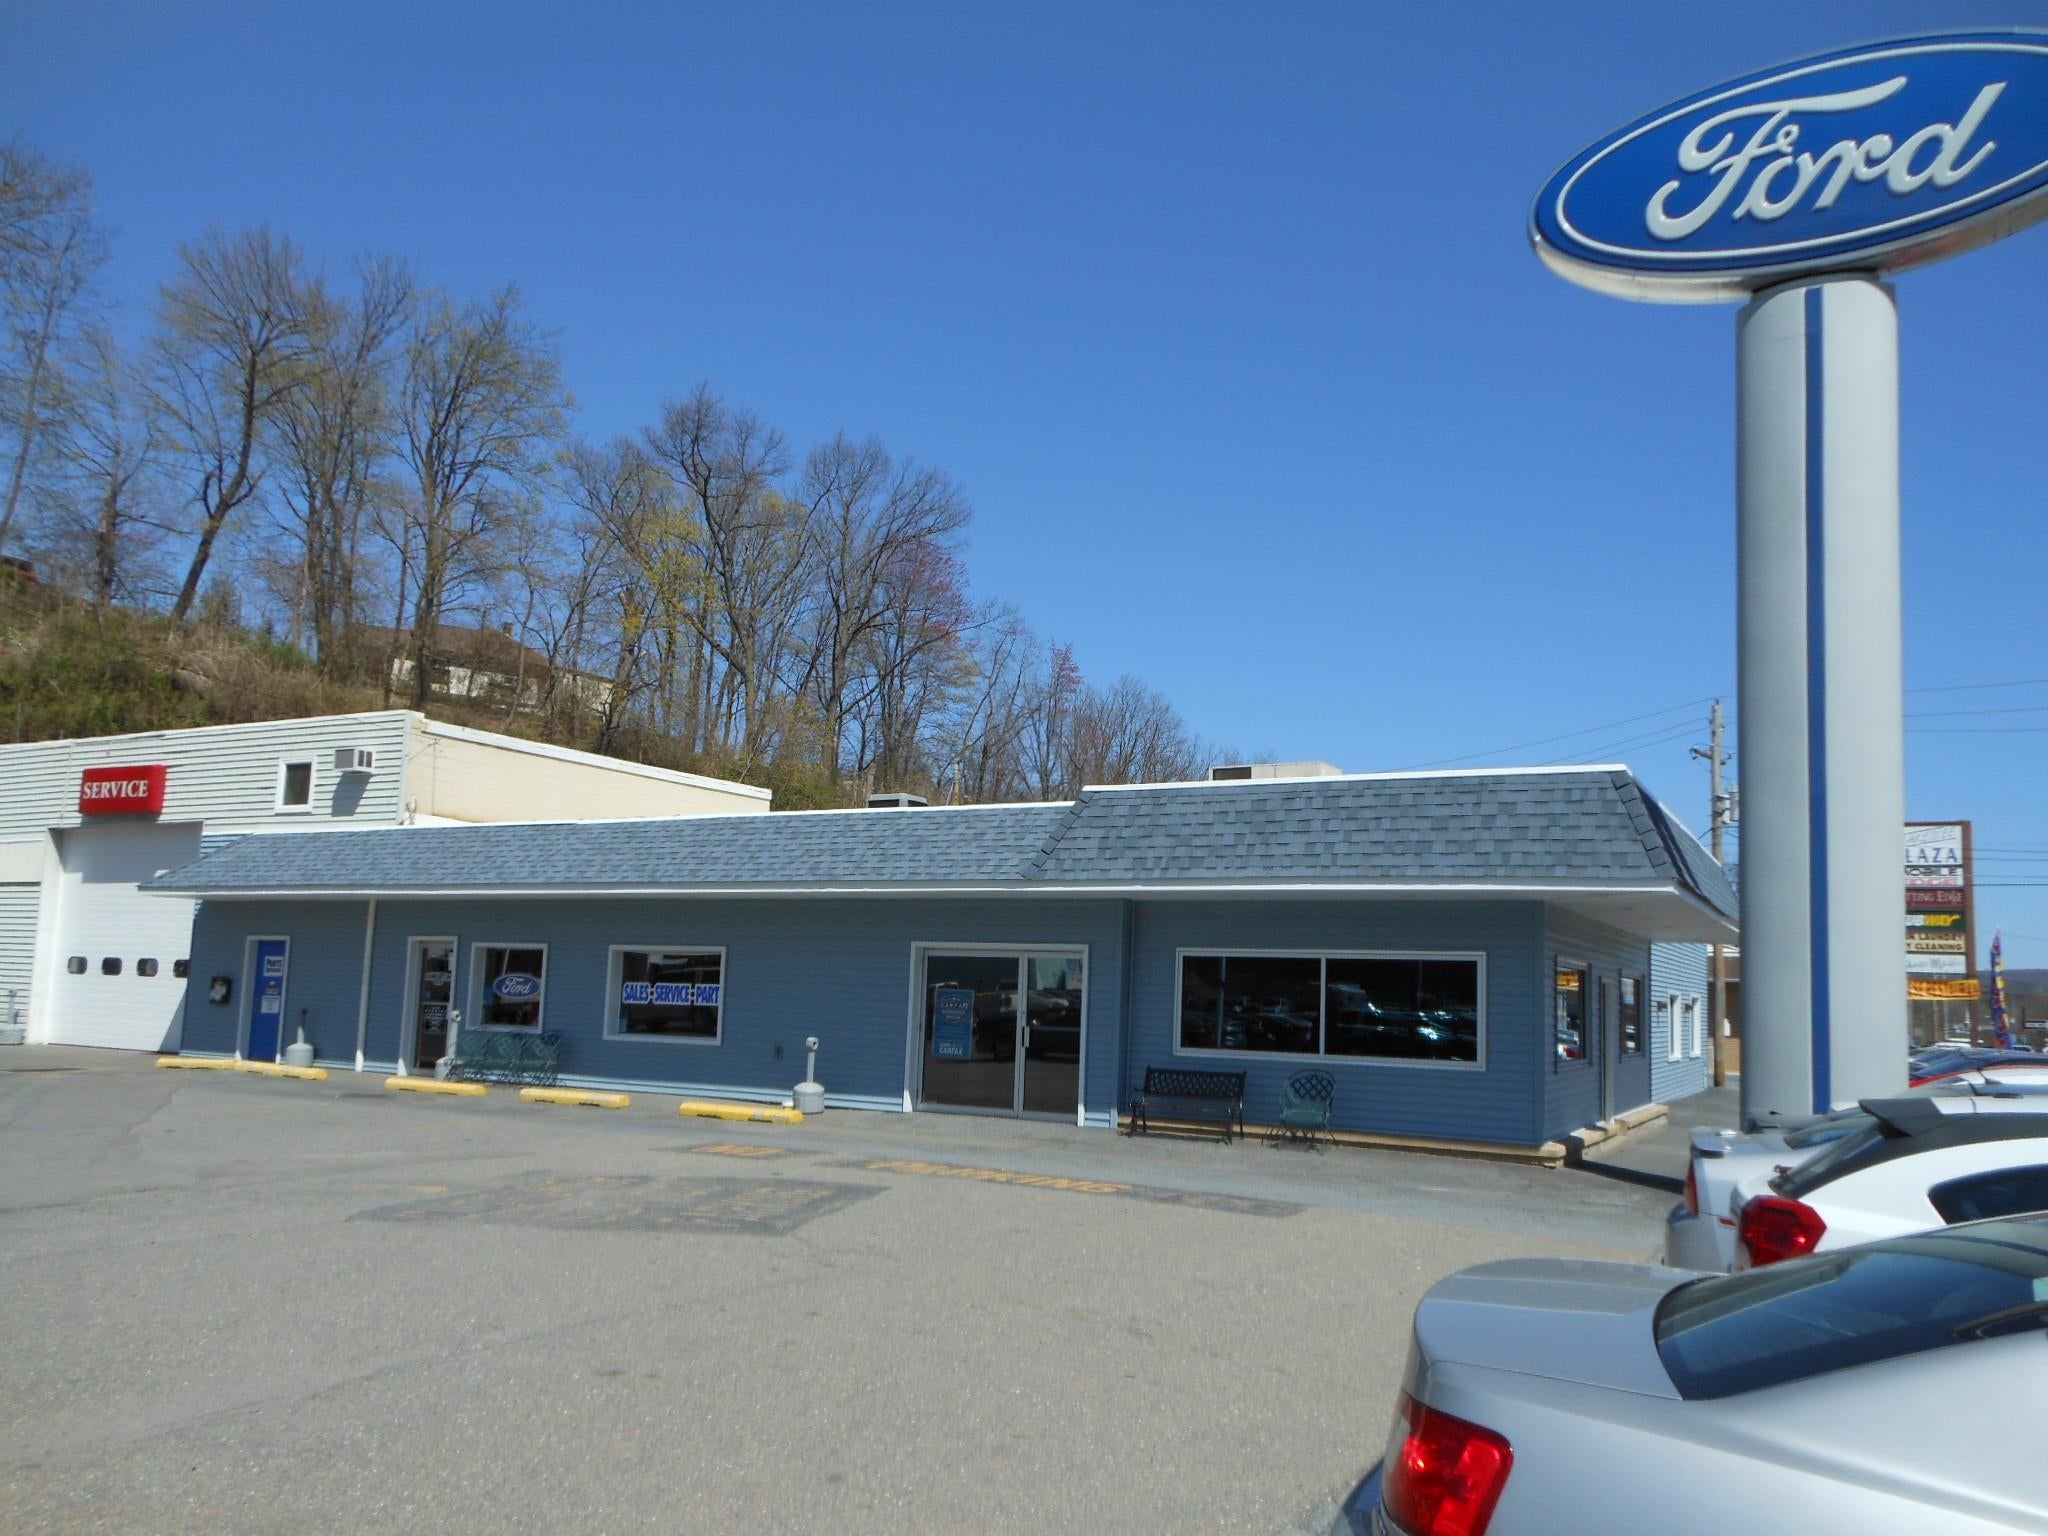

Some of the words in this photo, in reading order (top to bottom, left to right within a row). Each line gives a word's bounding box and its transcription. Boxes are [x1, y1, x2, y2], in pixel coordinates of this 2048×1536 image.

[1645, 76, 2008, 241] Ford
[82, 780, 149, 800] SERVICE
[502, 976, 532, 994] Ford
[624, 983, 649, 1003] SALES
[654, 984, 691, 1004] SERVICE
